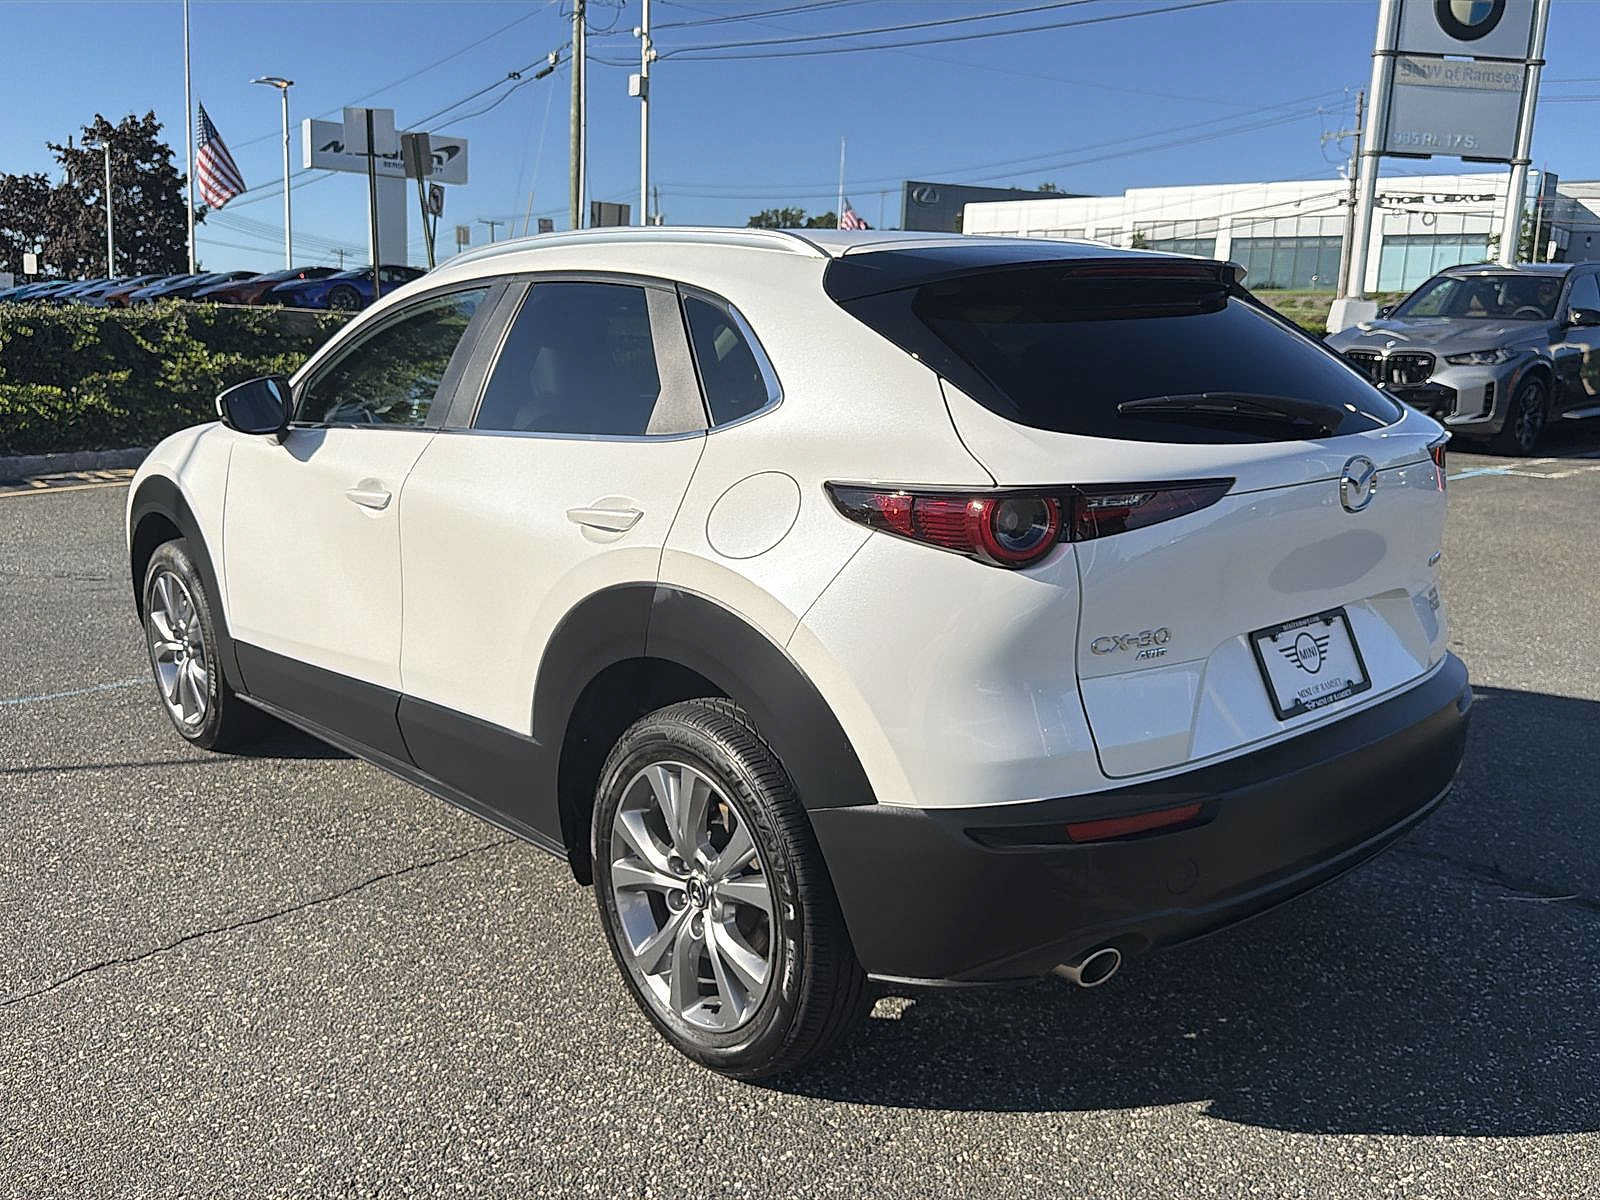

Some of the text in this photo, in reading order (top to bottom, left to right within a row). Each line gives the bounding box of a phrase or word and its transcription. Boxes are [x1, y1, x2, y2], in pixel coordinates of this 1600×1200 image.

[1444, 65, 1461, 80] of
[1464, 66, 1520, 86] Ramsey
[1090, 627, 1171, 656] CX-30
[1299, 646, 1318, 661] MINI
